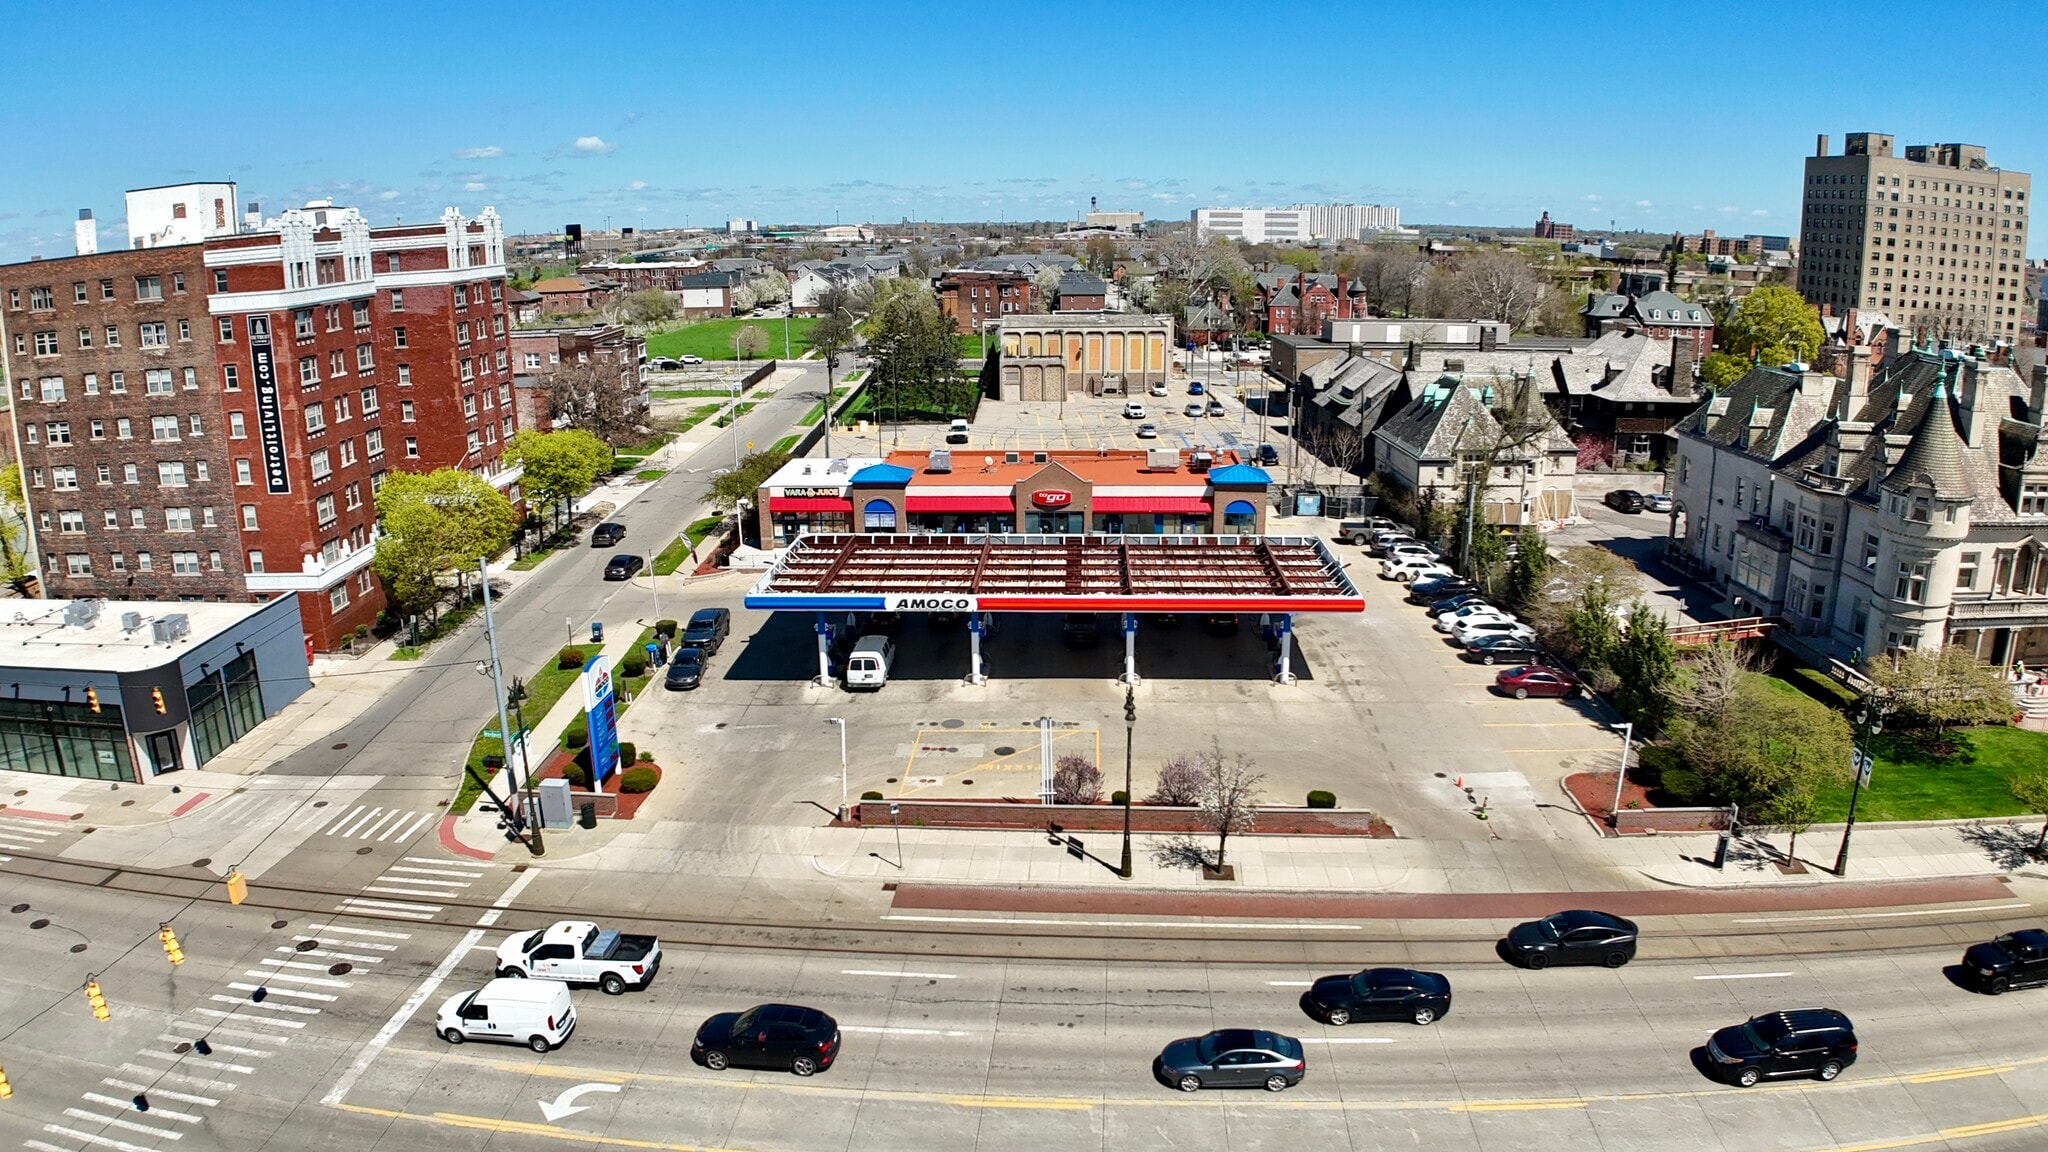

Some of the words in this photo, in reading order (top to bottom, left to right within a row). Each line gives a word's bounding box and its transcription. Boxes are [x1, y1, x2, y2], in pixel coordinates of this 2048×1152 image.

[257, 352, 283, 486] DetroitLiving.com
[785, 488, 807, 496] VARA
[816, 488, 839, 496] JUICE
[1046, 494, 1066, 503] go
[896, 599, 969, 609] AMOCO
